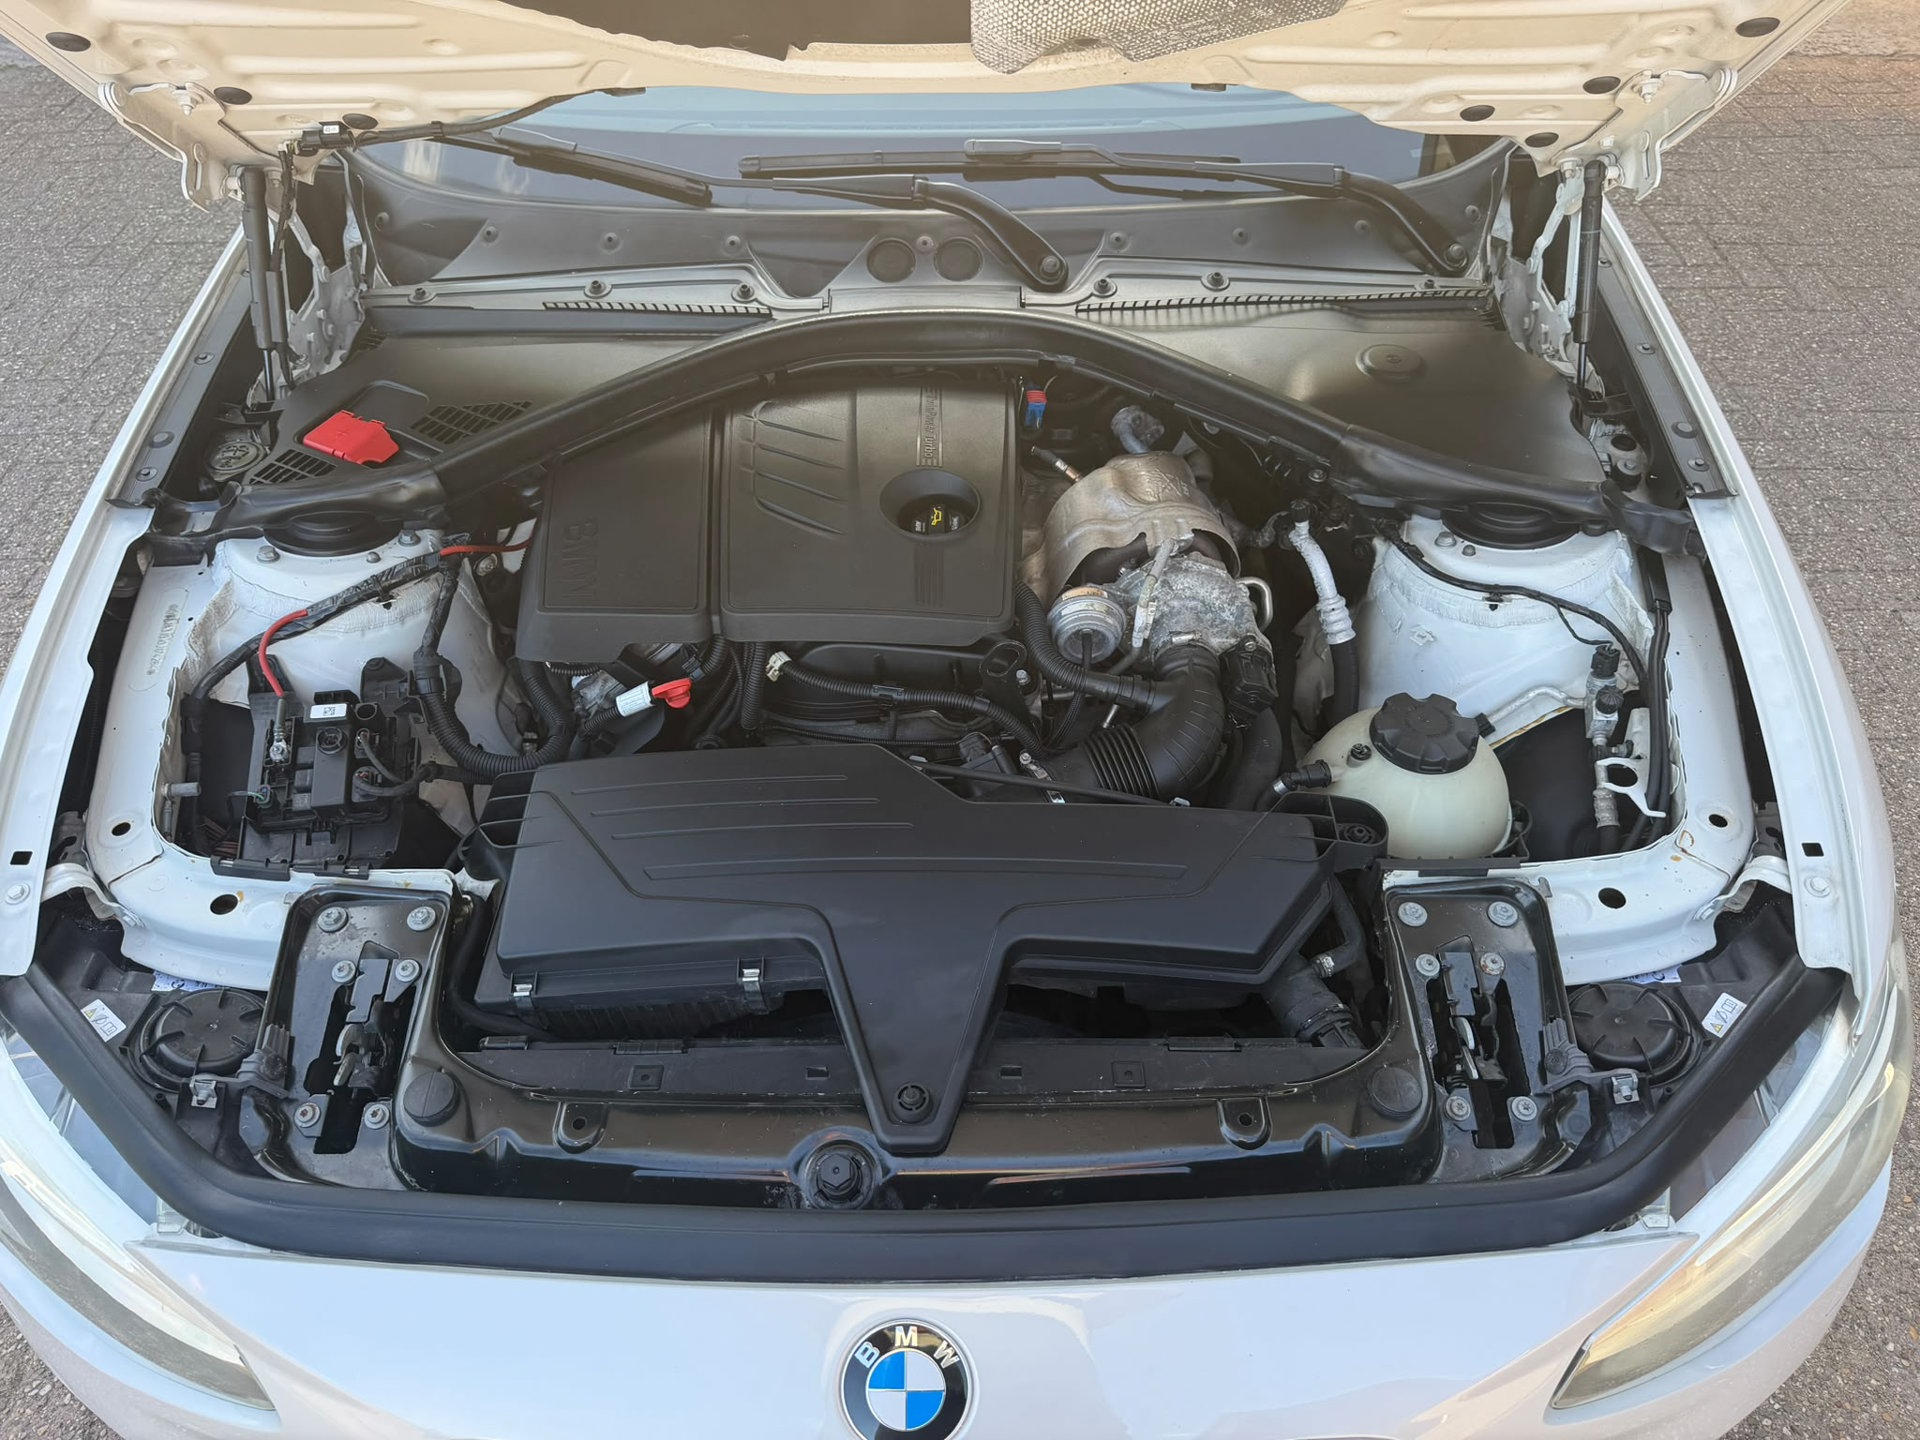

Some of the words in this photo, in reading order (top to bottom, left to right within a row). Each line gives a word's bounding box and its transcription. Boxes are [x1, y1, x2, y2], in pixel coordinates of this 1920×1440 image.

[924, 434, 937, 458] Turbo
[561, 518, 599, 599] BMW
[854, 1325, 960, 1369] BMW
